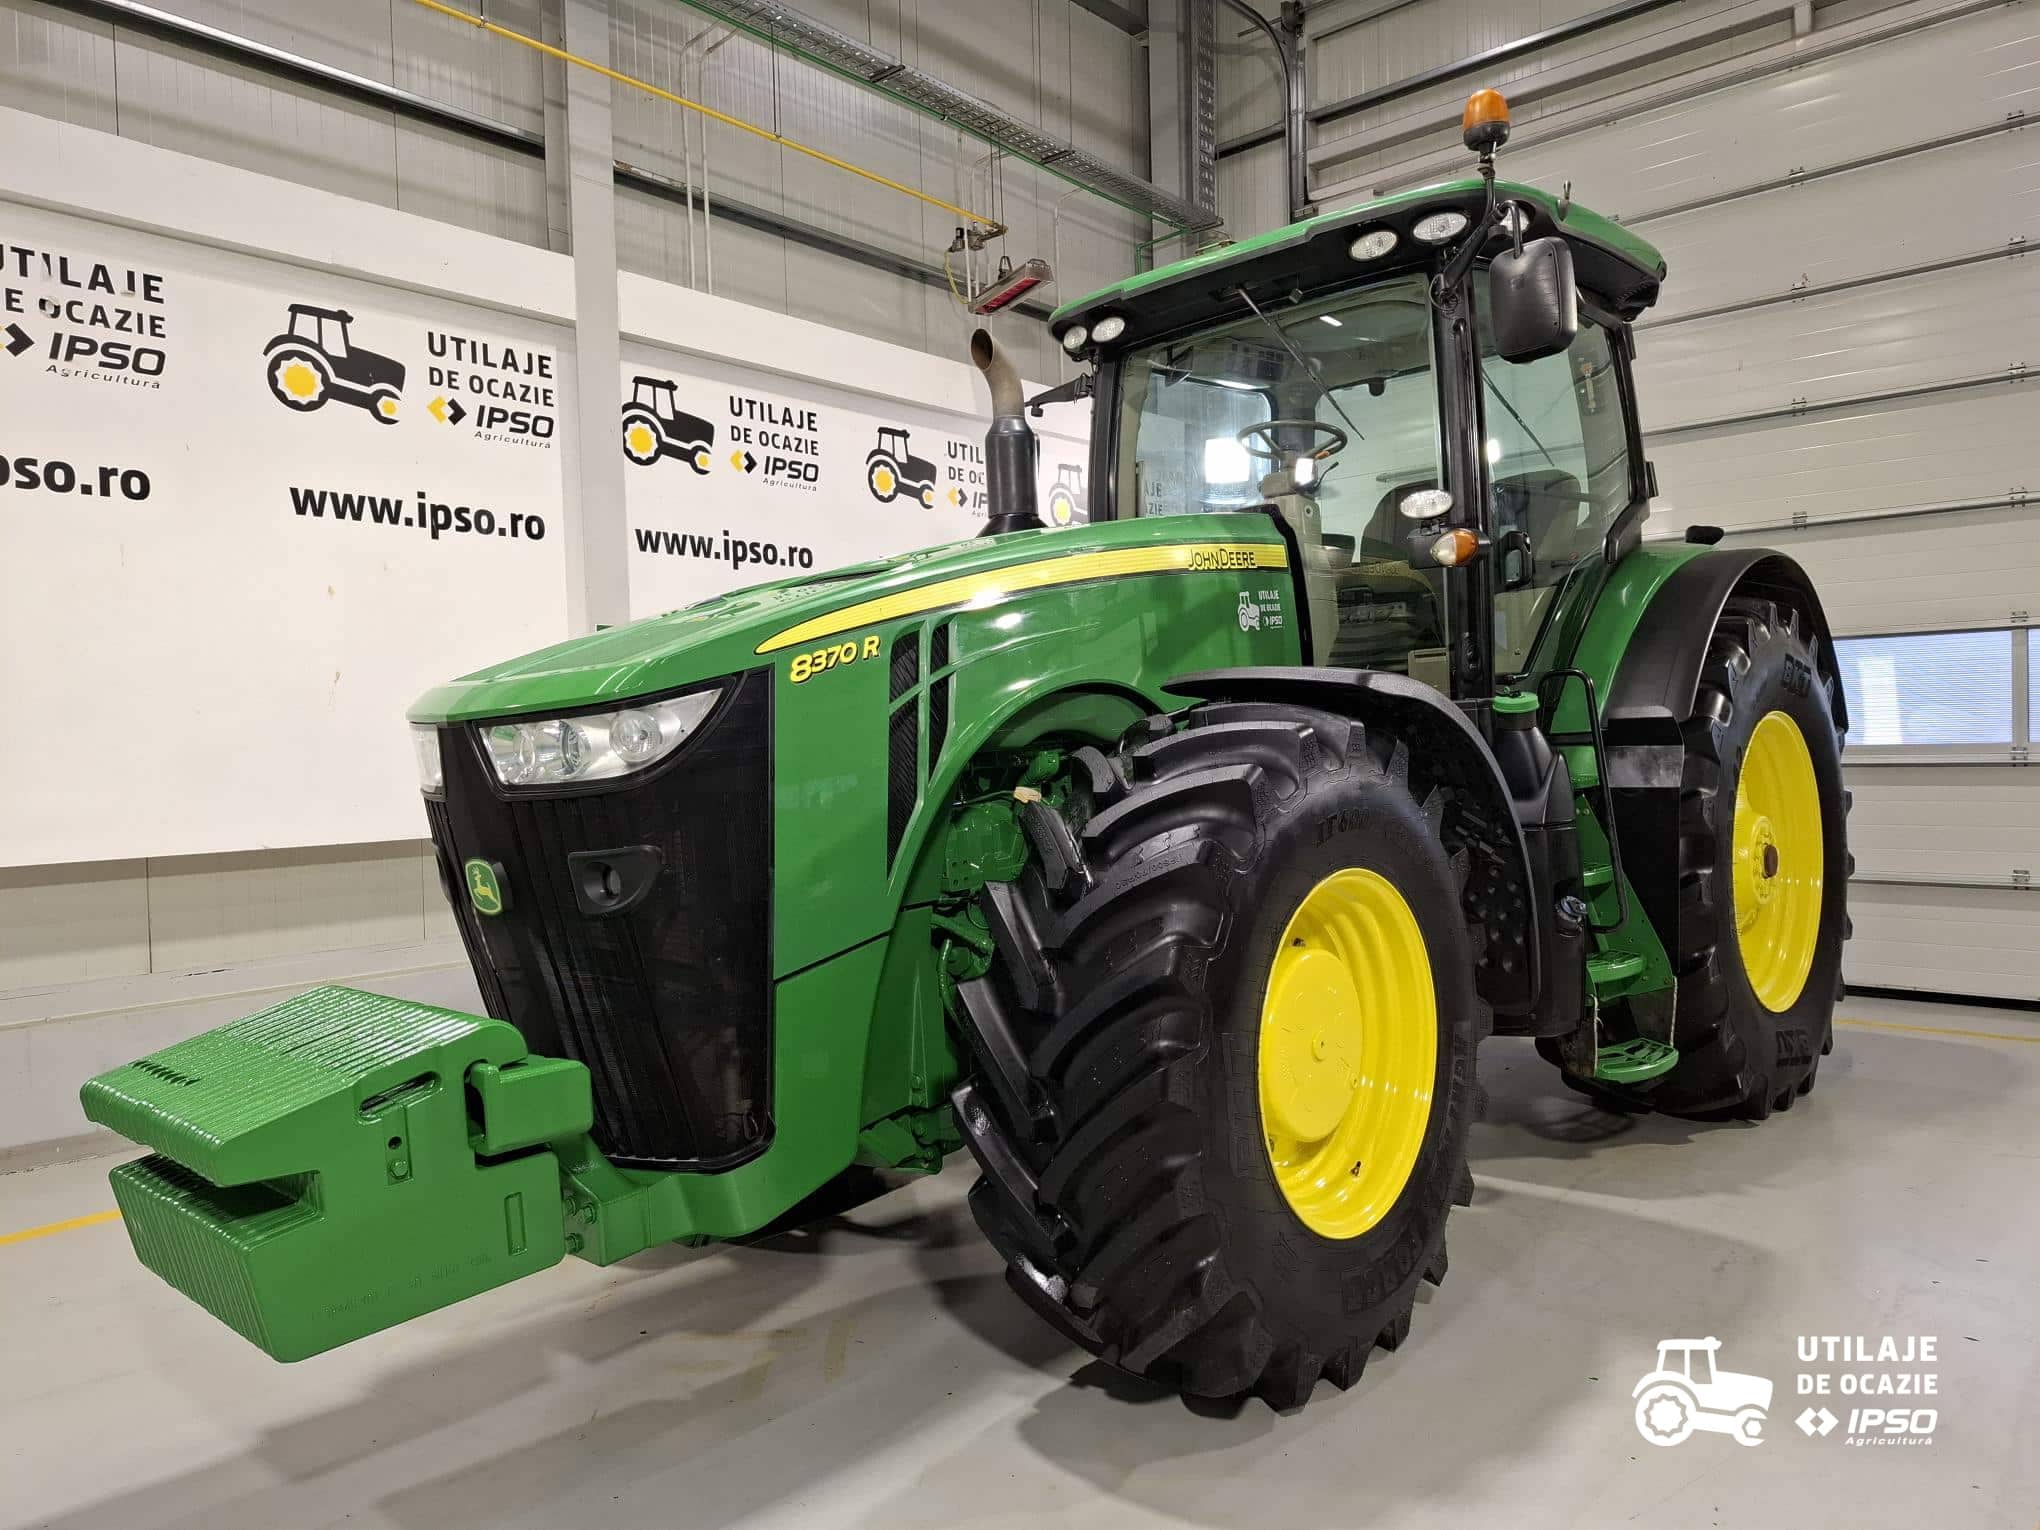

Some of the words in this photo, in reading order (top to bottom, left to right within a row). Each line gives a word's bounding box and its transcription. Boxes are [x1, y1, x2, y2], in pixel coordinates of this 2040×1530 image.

[0, 243, 164, 304] TILAJE
[39, 298, 166, 339] OCAZIE
[49, 332, 166, 376] IPSO
[427, 331, 553, 379] UTILAJE
[429, 366, 460, 390] DE
[469, 375, 554, 407] OCAZIE
[476, 404, 554, 438] IPSO
[729, 395, 818, 432] UTILAJE
[730, 425, 753, 444] DE
[759, 430, 819, 456] OCAZIE
[764, 456, 819, 483] IPSO
[948, 466, 965, 482] DE
[289, 487, 546, 541] www.ipso.ro
[635, 529, 813, 570] www.ipso.ro
[790, 641, 859, 684] 8370
[862, 635, 881, 661] R
